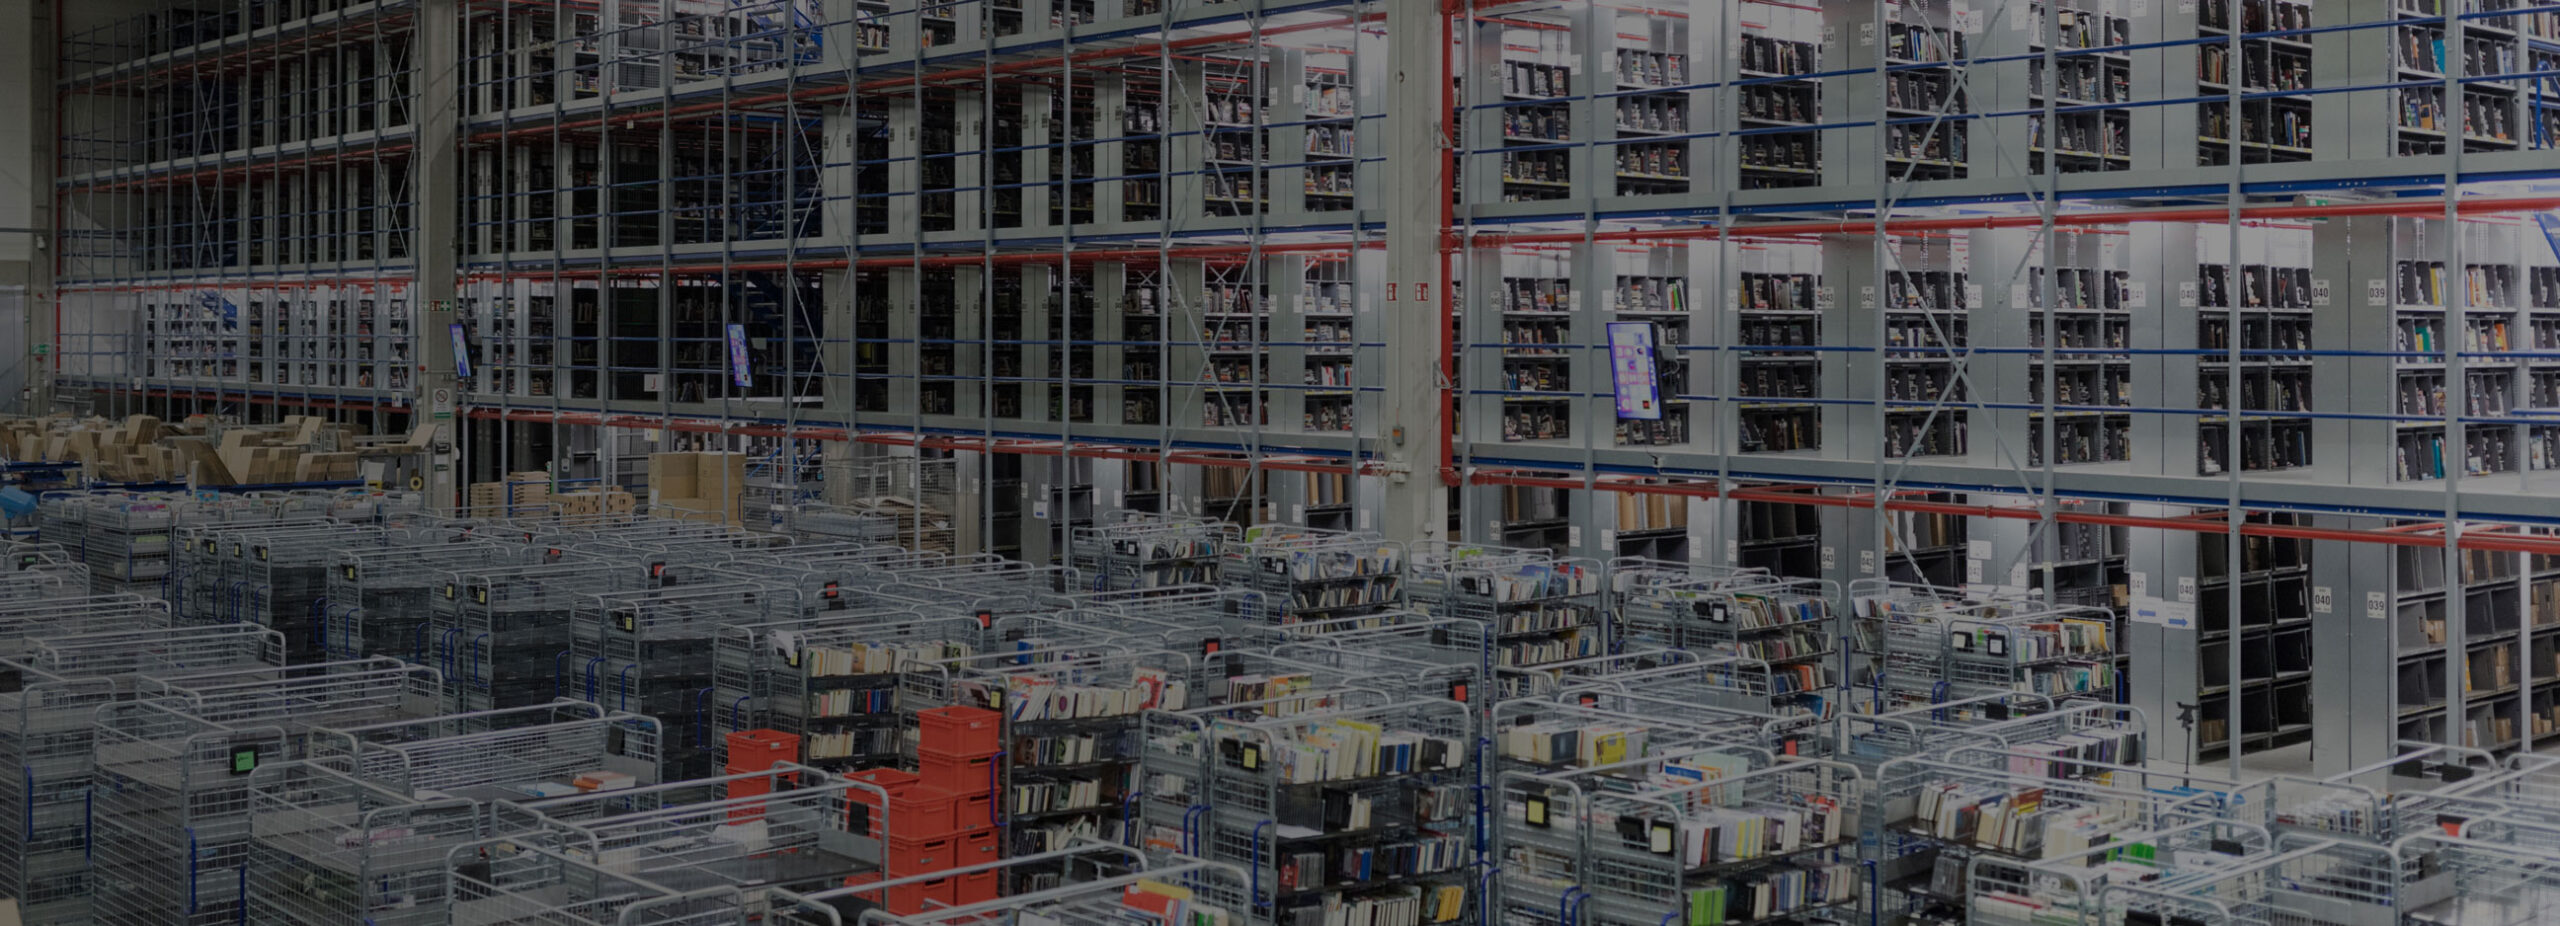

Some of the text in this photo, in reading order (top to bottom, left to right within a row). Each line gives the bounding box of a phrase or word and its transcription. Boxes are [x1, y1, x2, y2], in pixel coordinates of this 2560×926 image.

[2181, 290, 2195, 299] 040
[2313, 287, 2329, 298] 040
[2369, 288, 2386, 298] 039
[2179, 584, 2194, 595] 040
[2315, 594, 2330, 605] 040
[2368, 600, 2385, 611] 039
